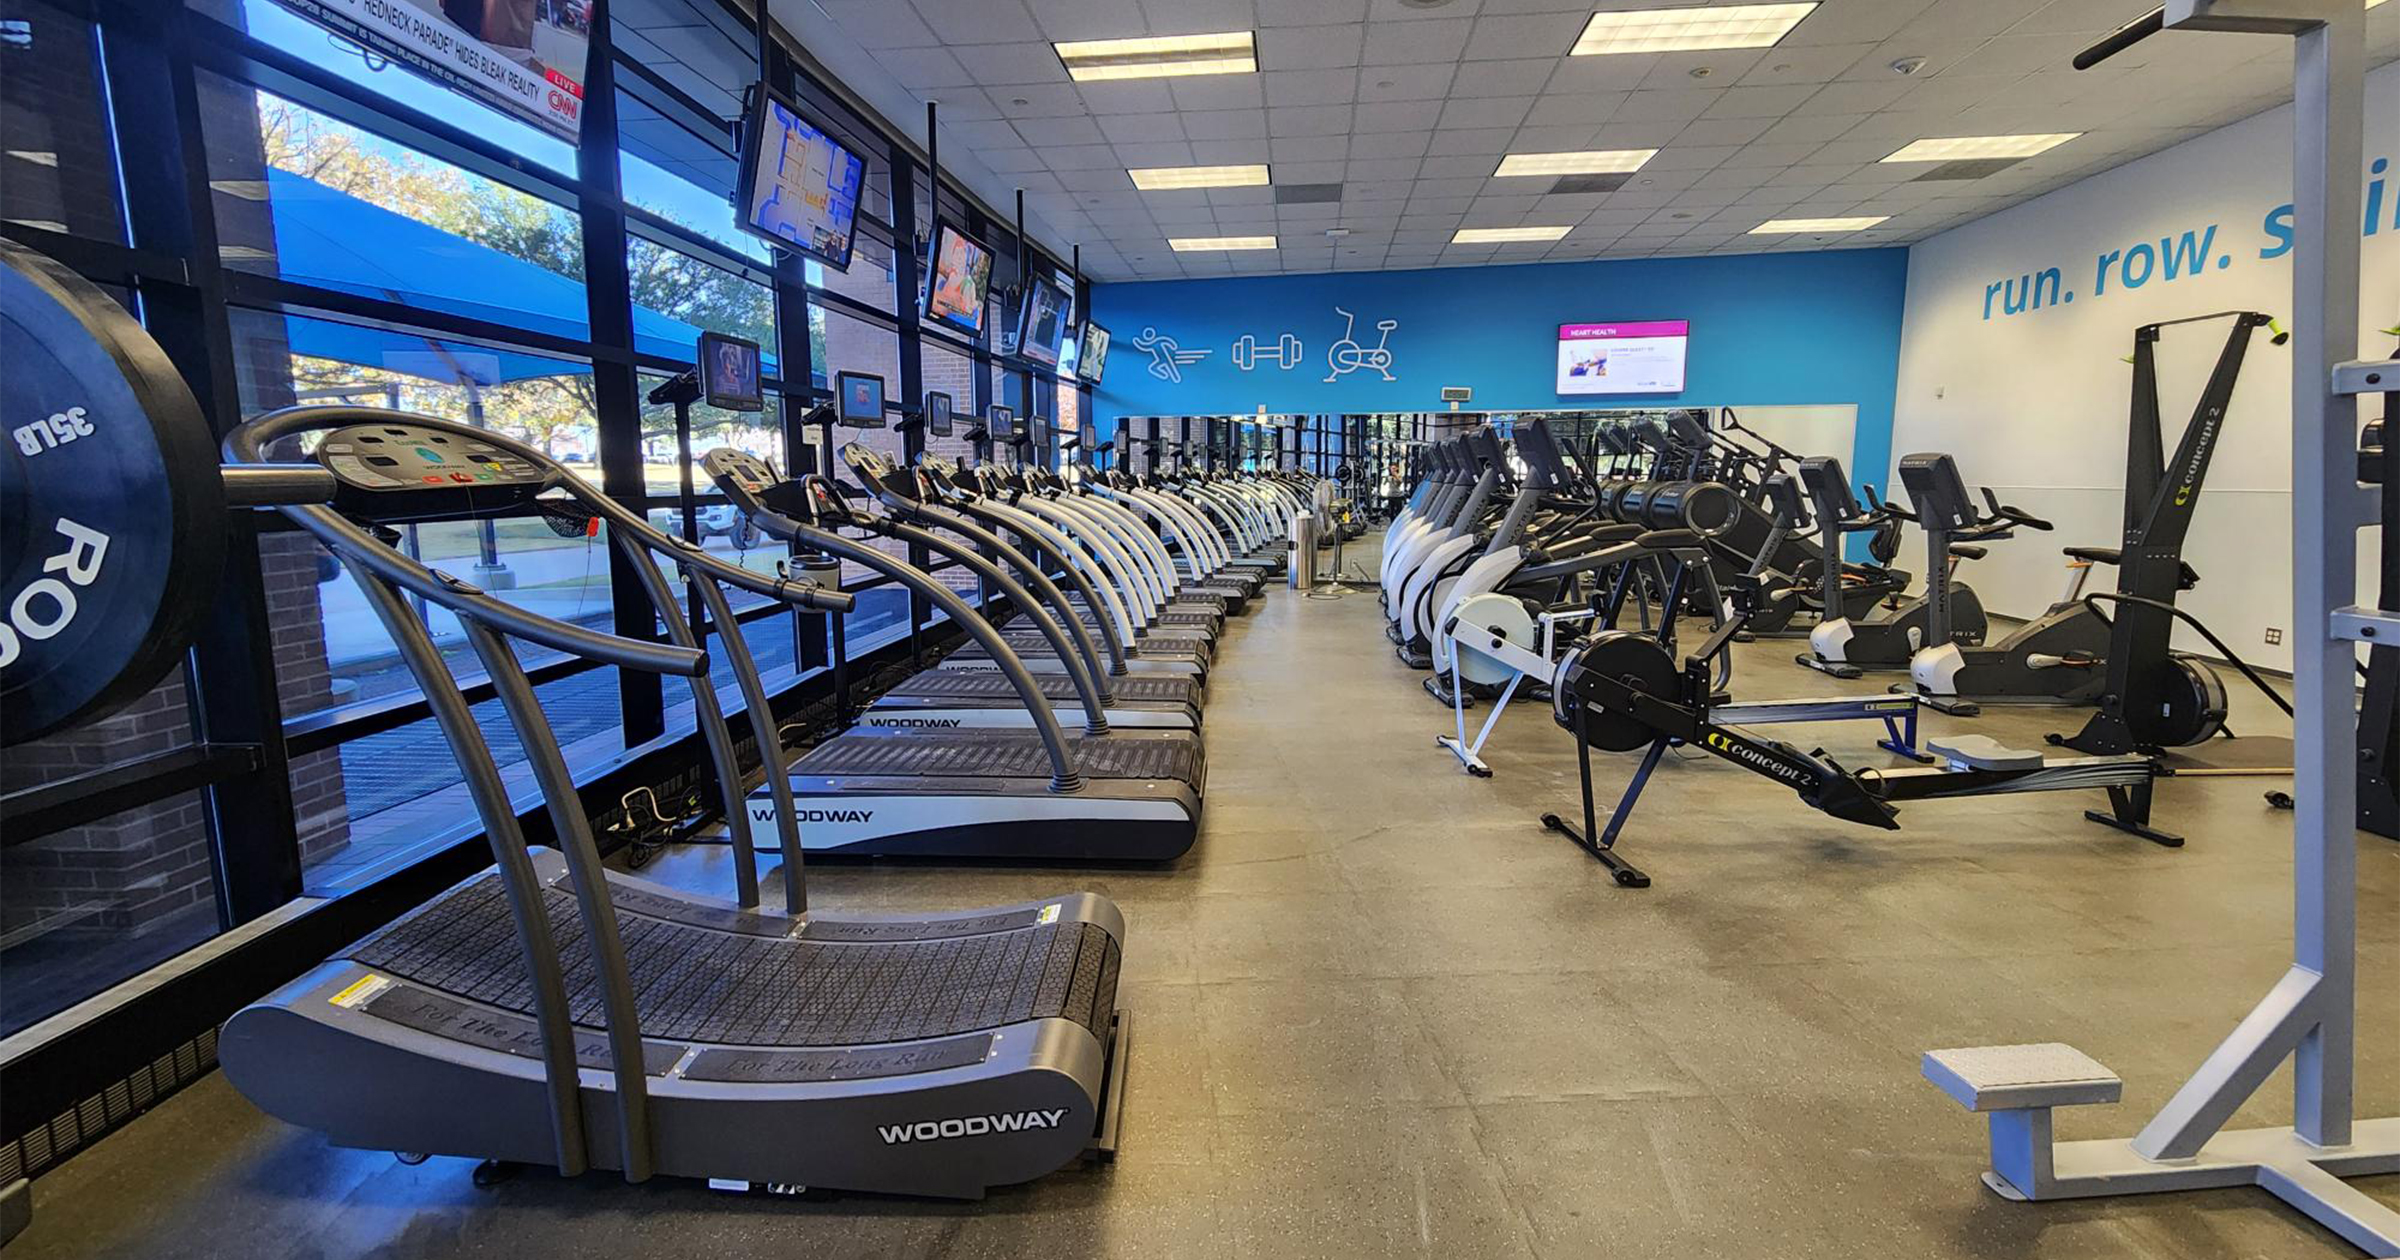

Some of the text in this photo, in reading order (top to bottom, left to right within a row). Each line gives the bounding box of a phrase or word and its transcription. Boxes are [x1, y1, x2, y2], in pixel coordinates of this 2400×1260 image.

[454, 41, 480, 69] HIDES
[480, 56, 507, 84] BLEAK
[508, 71, 540, 101] REALITY
[554, 74, 576, 93] LIVE
[547, 89, 577, 119] CNN
[1982, 266, 2075, 320] run.
[2094, 224, 2231, 297] row.
[1592, 328, 1617, 336] HEALTH
[13, 406, 94, 457] 35LB
[2184, 406, 2220, 484] concept 2
[870, 718, 961, 728] WOODWAY
[1731, 743, 1812, 786] concept 2
[752, 809, 874, 823] WODWAY
[878, 1108, 1069, 1144] WOODWAY
